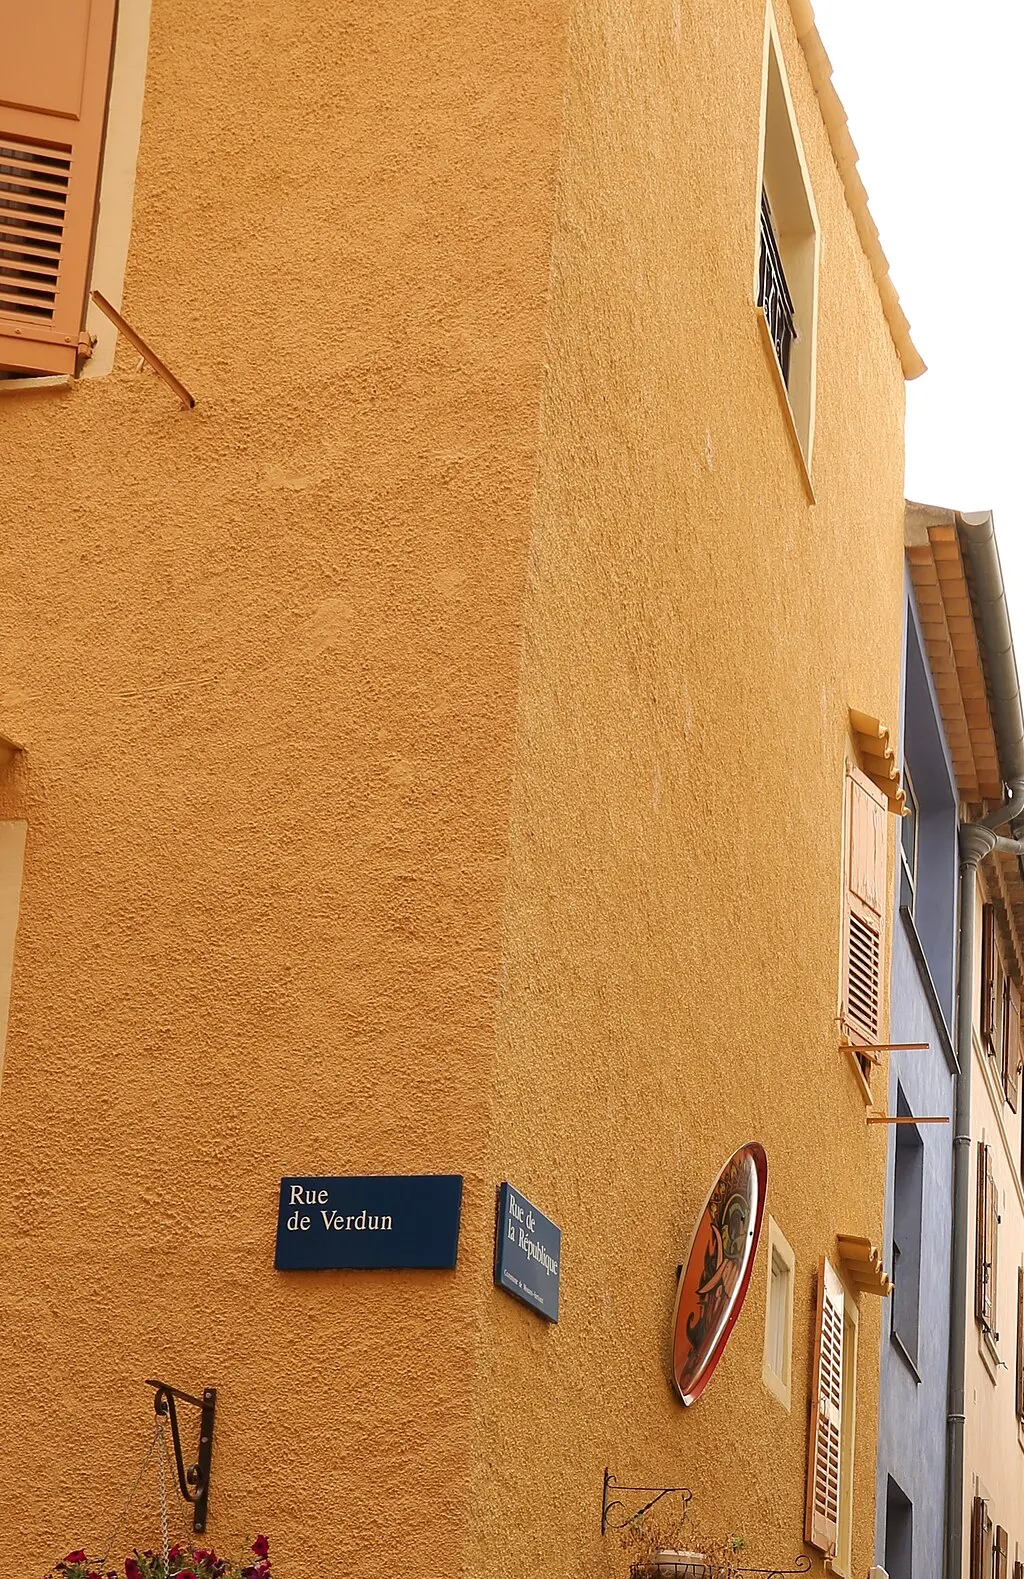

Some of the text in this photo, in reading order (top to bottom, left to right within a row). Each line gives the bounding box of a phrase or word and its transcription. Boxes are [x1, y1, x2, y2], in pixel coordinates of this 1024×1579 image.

[289, 1185, 329, 1205] Rue
[287, 1210, 393, 1231] de Verdun
[509, 1193, 536, 1233] Rue de
[507, 1218, 558, 1276] la République
